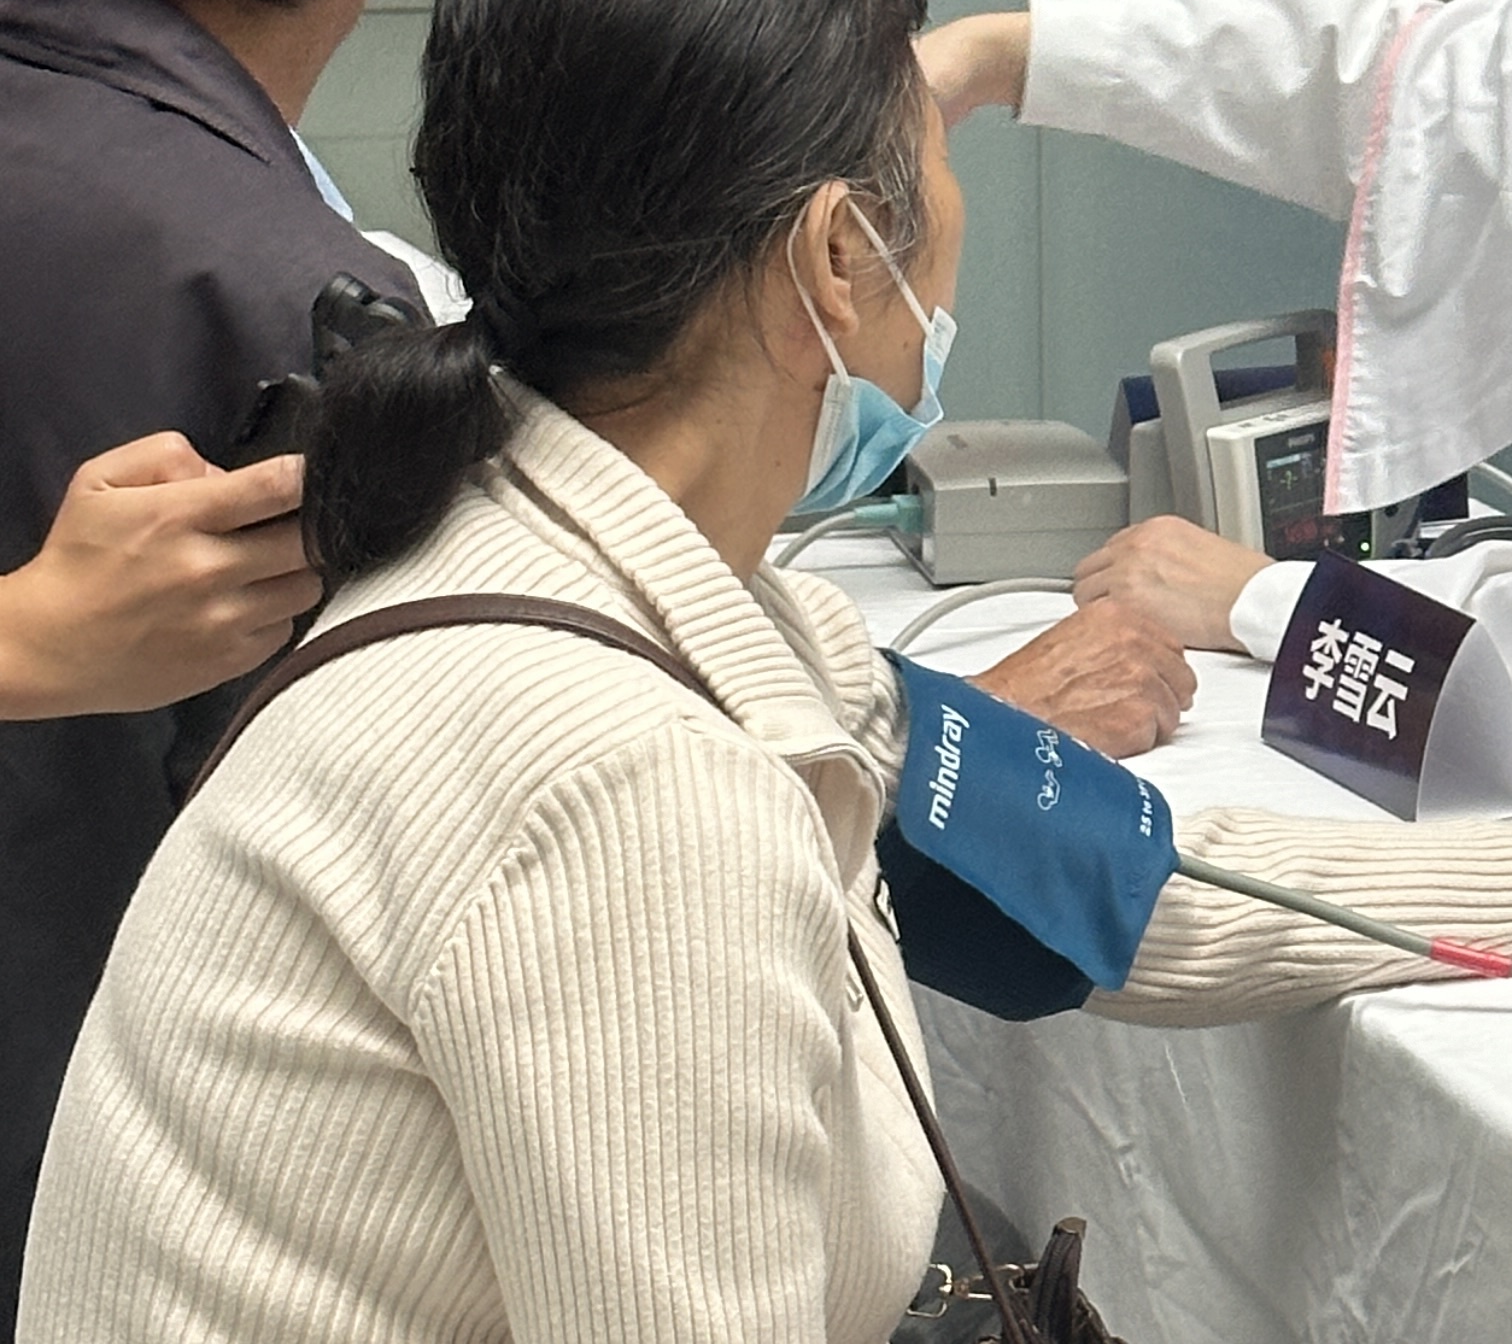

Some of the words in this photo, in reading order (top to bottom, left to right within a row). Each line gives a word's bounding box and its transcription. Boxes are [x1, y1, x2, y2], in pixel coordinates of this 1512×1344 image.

[1302, 618, 1416, 740] 李雪云
[928, 704, 971, 831] mindray
